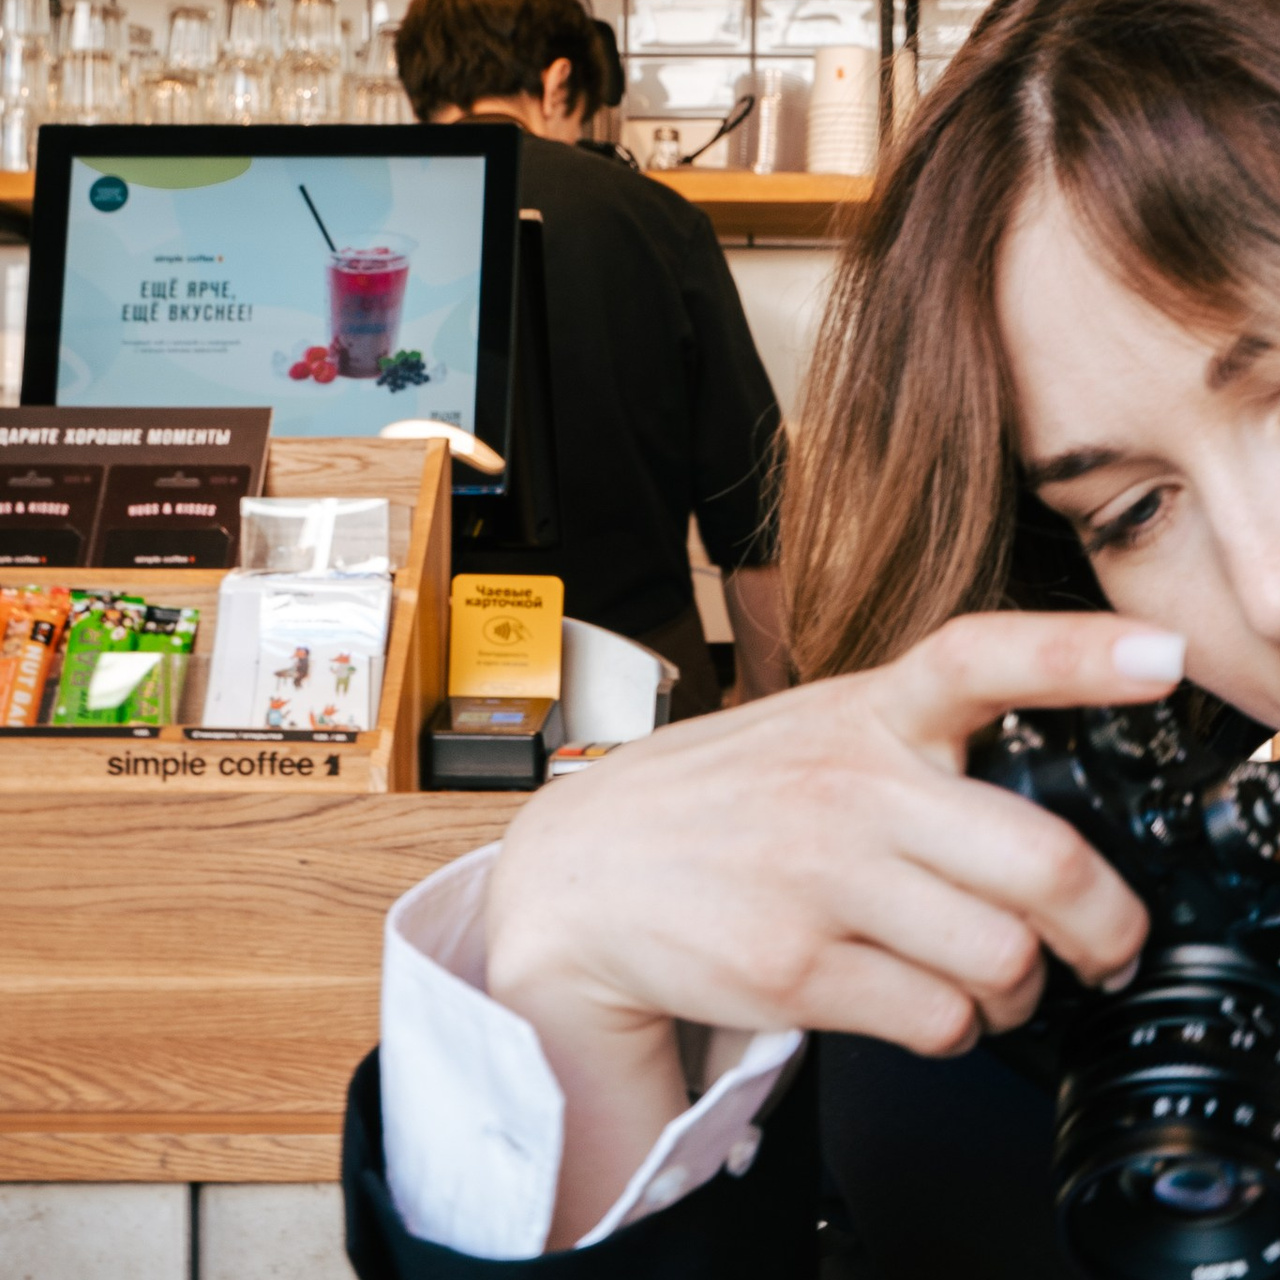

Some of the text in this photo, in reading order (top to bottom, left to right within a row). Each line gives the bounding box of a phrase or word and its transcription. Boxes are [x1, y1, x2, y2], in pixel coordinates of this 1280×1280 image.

[140, 278, 236, 300] ЕЩЁ ЯРЧЕ,
[122, 302, 253, 324] ЕЩЁ ВКУСНЕЕ!
[64, 427, 143, 445] ХОРОШИЕ
[147, 428, 231, 446] МОМЕНТЫ
[476, 585, 532, 597] Чаевые
[465, 596, 542, 609] карточкой
[18, 644, 43, 687] NUT
[107, 751, 314, 782] simple coffee
